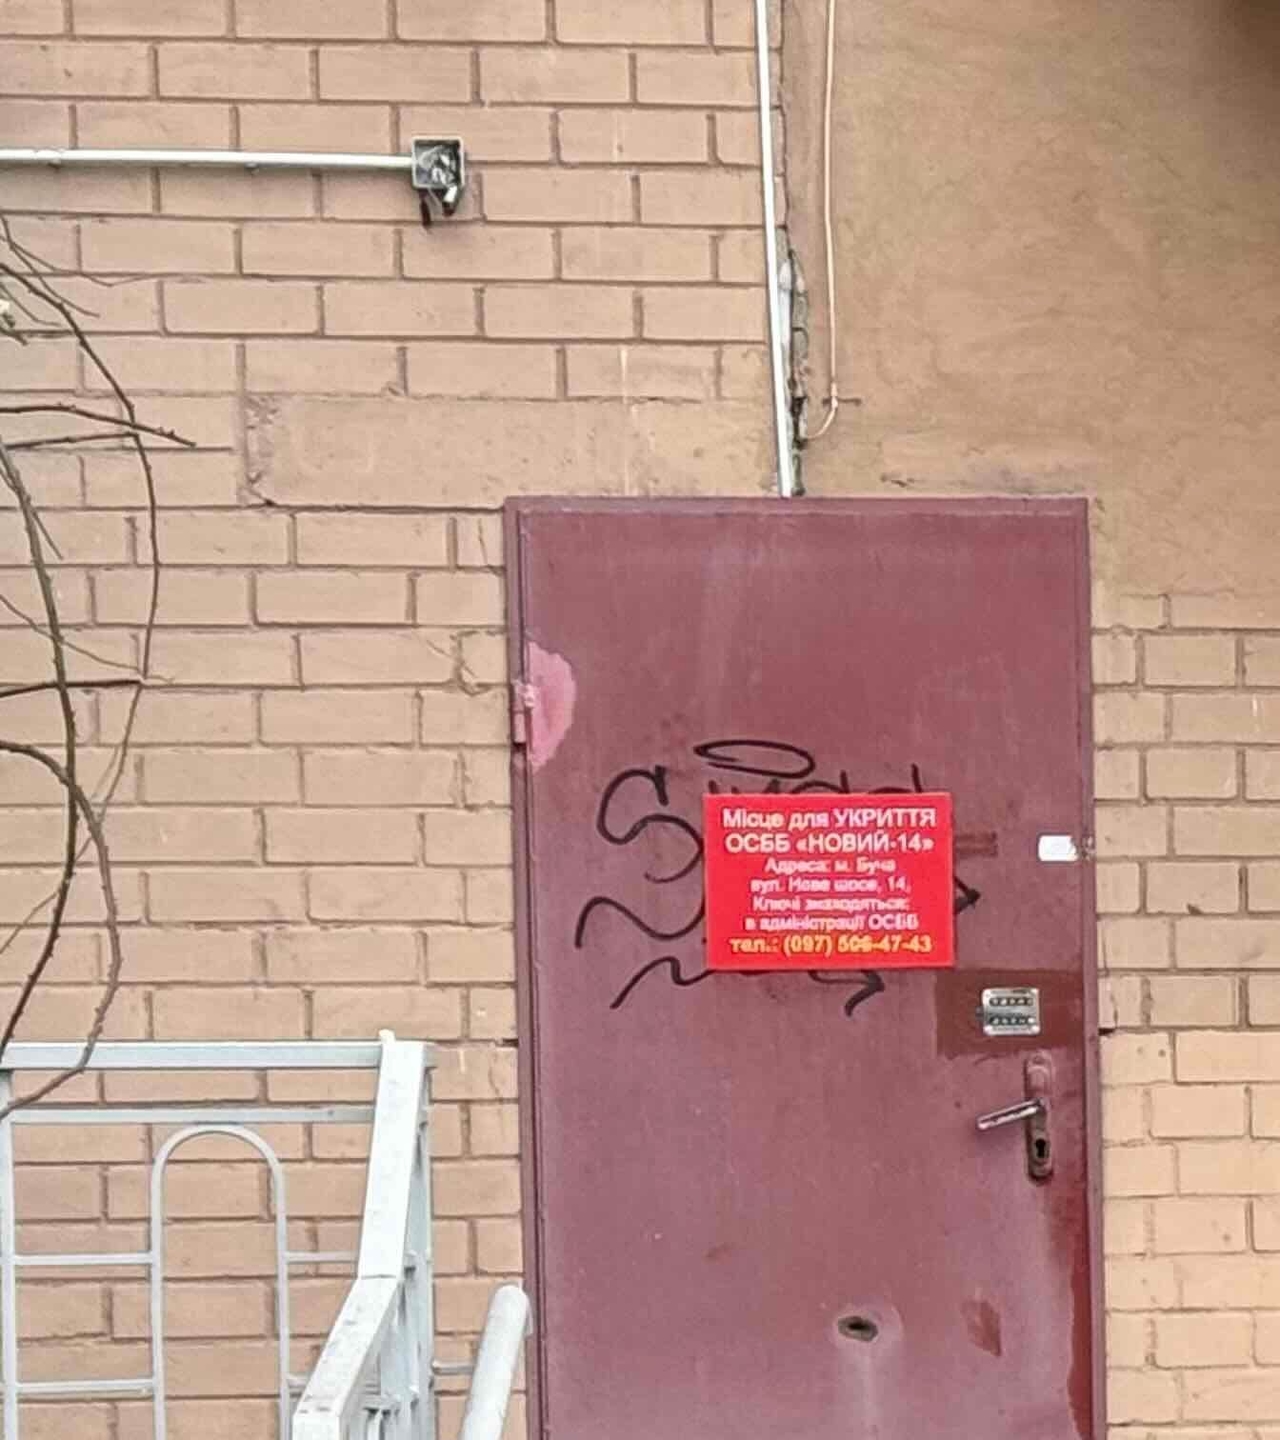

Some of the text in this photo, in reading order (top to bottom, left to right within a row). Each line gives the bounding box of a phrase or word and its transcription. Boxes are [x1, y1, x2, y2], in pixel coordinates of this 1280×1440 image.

[723, 808, 936, 831] Місце для УКРИТТЯ
[725, 829, 935, 853] ОСББ «НОВИЙ-14»
[764, 857, 896, 875] Адреса: м. Буча
[750, 879, 782, 894] вул.
[753, 895, 800, 911] Ключі
[745, 918, 756, 930] в
[760, 915, 865, 932] адміністрації
[783, 935, 832, 958] (097)
